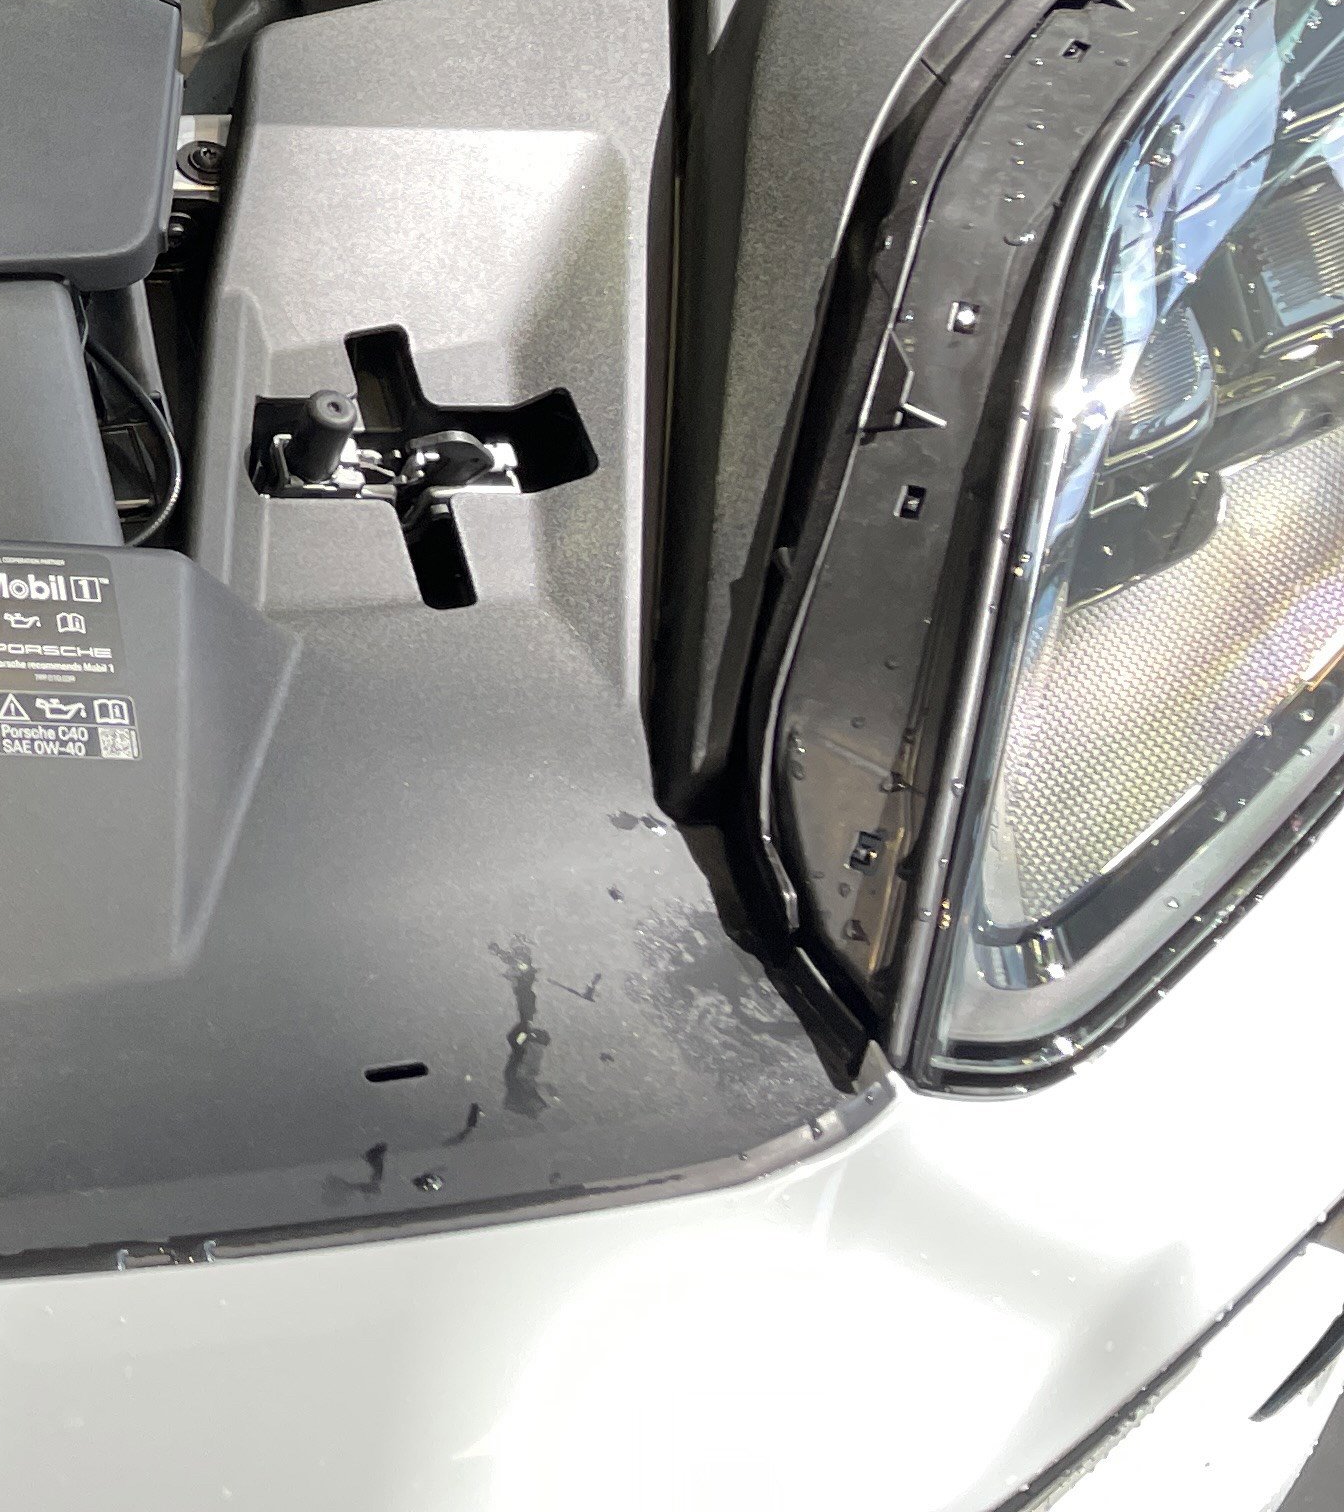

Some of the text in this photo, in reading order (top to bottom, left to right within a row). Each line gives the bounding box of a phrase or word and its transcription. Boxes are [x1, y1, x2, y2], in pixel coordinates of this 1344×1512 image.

[0, 723, 89, 742] Porsche C40
[2, 739, 86, 756] SAE 0W-40
